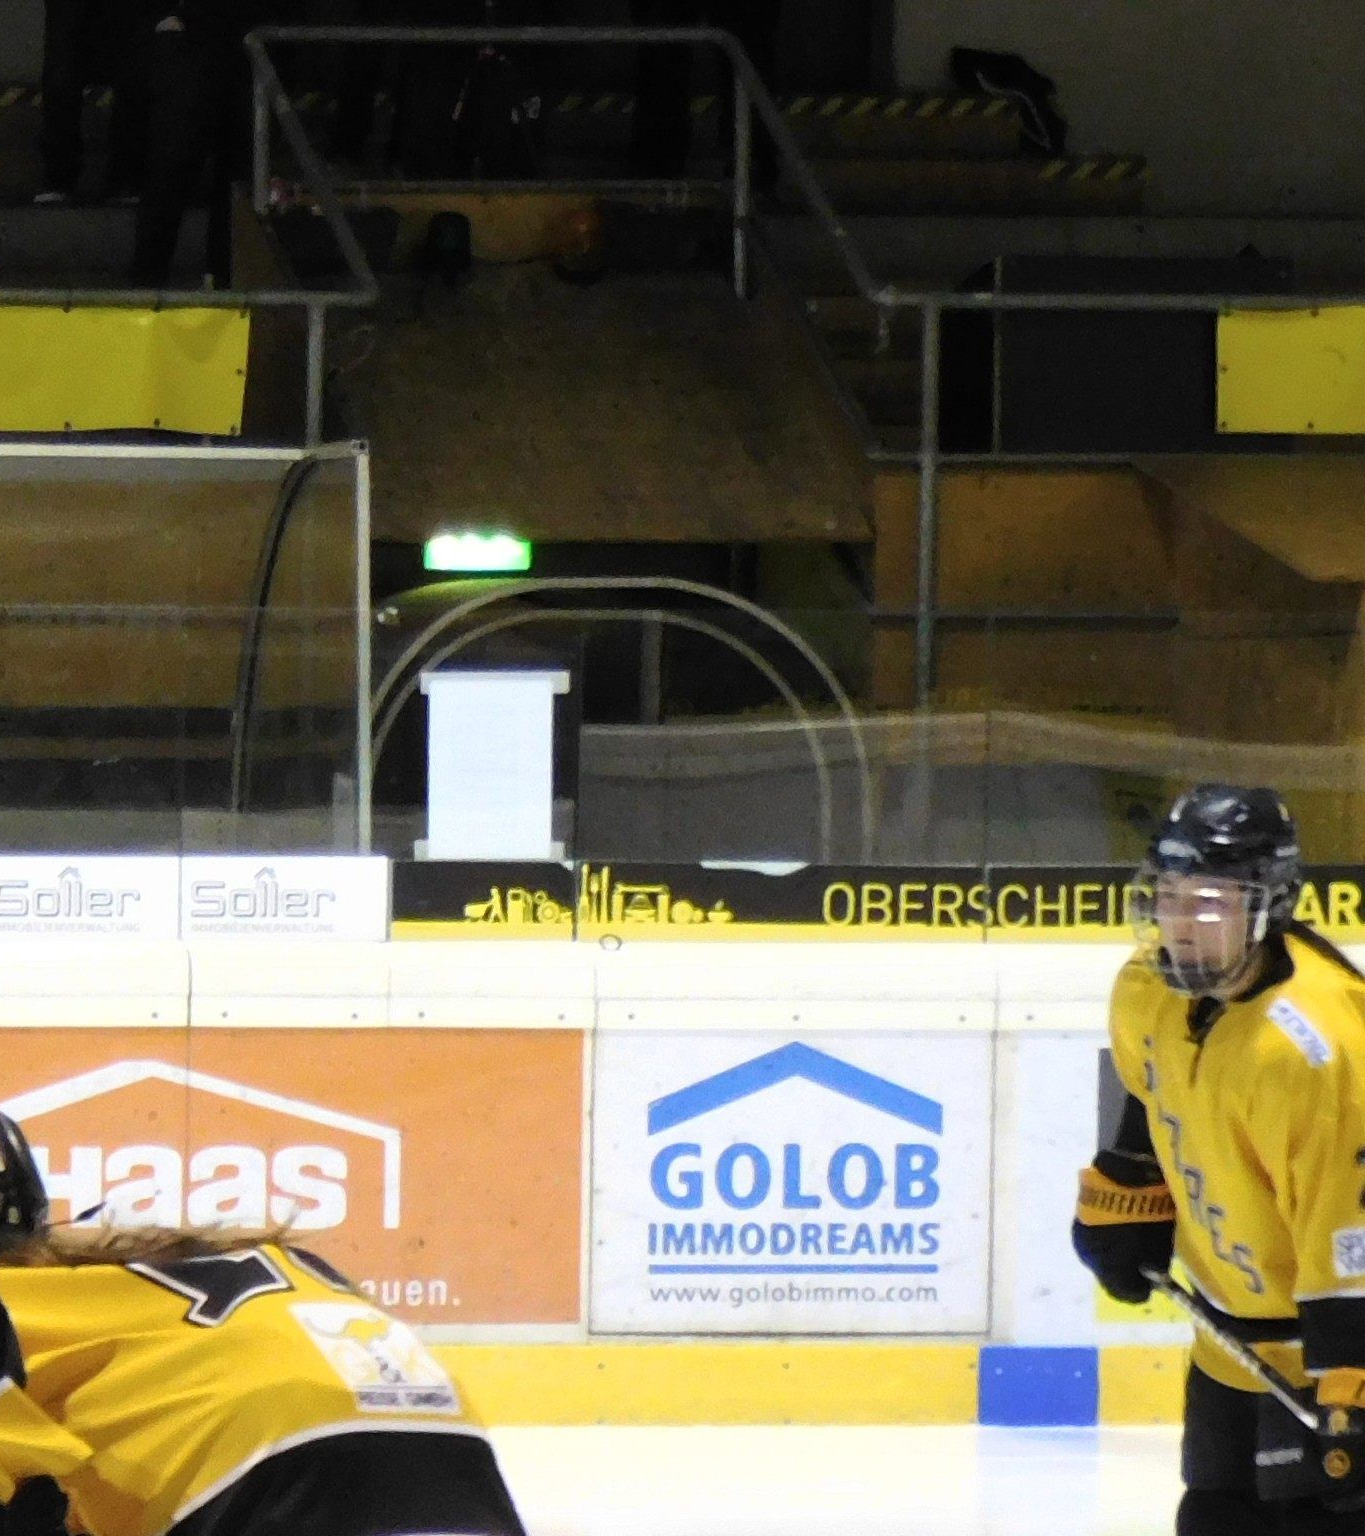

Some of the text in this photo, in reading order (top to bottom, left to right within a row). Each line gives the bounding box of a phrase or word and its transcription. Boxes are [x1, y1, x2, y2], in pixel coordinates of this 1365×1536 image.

[191, 870, 337, 917] Soller
[650, 1142, 942, 1211] GOLOB
[647, 1222, 940, 1256] IMMODREAMS
[649, 1280, 940, 1308] www.golobimmo.com
